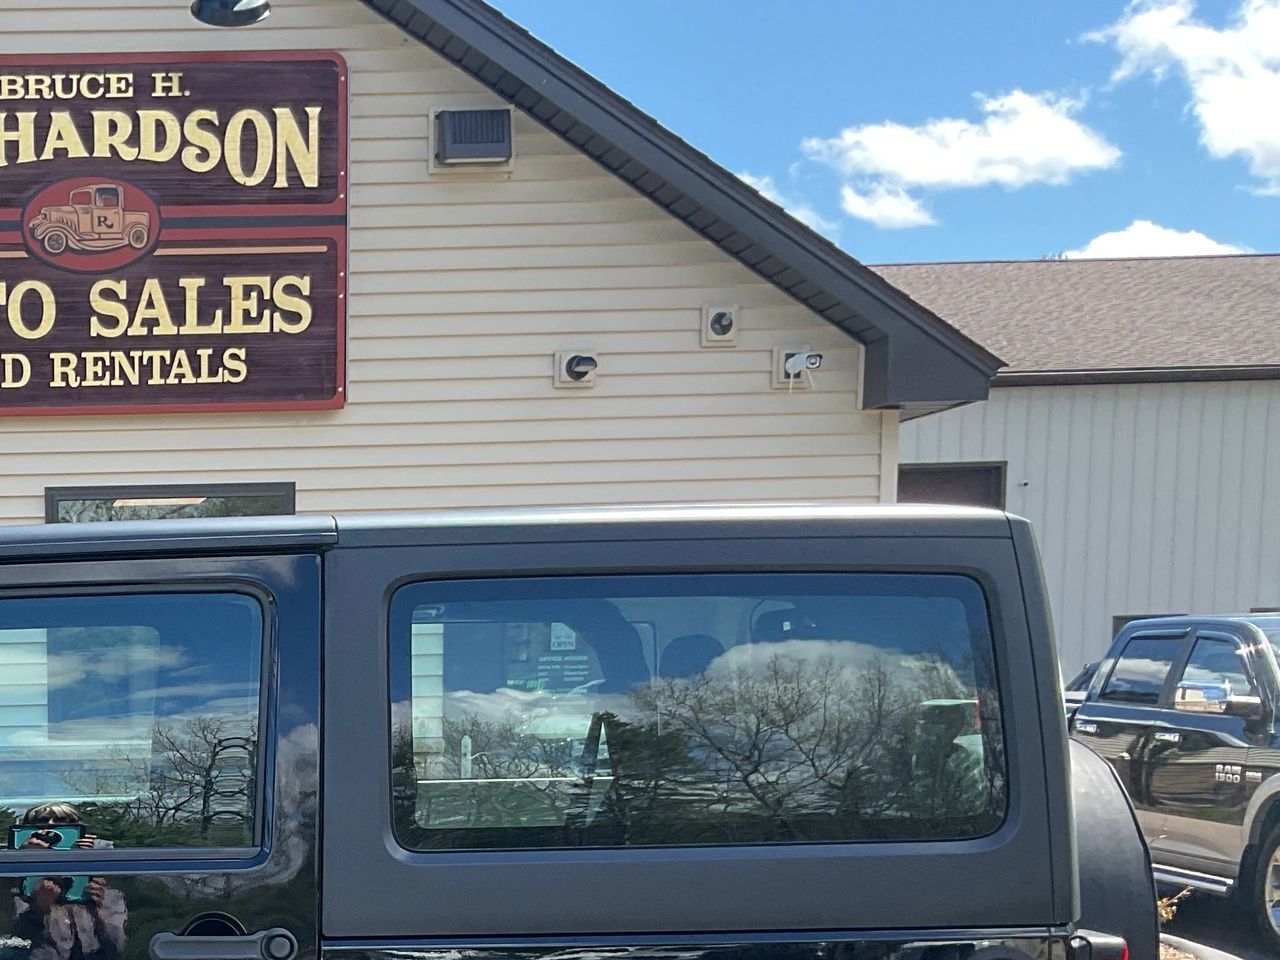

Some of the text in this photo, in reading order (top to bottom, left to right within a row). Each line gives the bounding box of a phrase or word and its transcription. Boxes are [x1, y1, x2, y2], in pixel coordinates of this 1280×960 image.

[151, 72, 191, 98] H.
[96, 215, 114, 229] R
[89, 275, 313, 338] SALES
[49, 347, 248, 390] RENTALS
[1215, 772, 1240, 783] 1500
